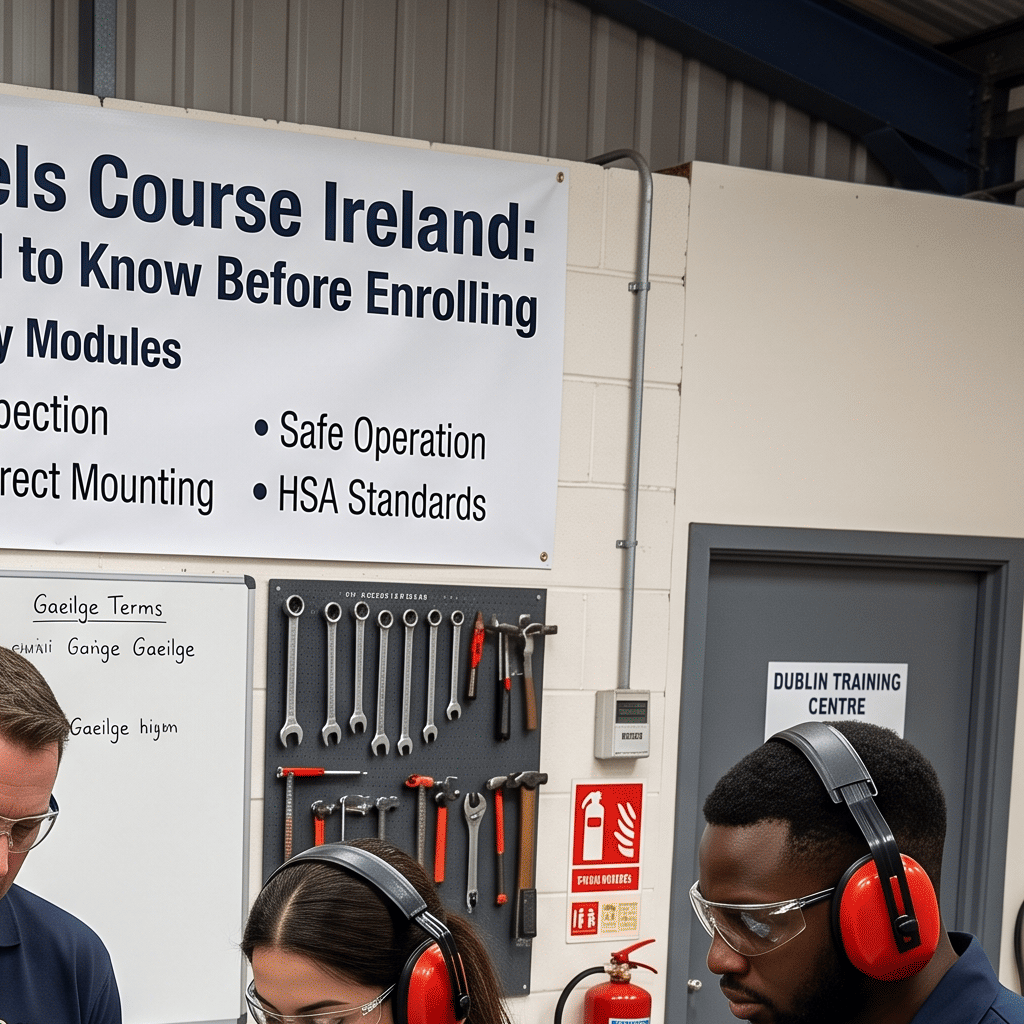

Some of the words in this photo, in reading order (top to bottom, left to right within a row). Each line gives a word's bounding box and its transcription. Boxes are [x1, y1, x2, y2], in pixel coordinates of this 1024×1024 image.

[89, 154, 302, 238] Course
[325, 181, 535, 262] Ireland:
[19, 237, 63, 285] to
[80, 241, 201, 297] Know
[217, 256, 351, 312] Before
[367, 270, 537, 338] Enrolling
[26, 318, 181, 369] Modules
[280, 410, 344, 450] Safe
[354, 416, 486, 461] Operation
[72, 463, 213, 515] Mounting
[279, 475, 338, 514] HSA
[348, 479, 486, 521] Standards
[33, 593, 99, 624] Gaeilge
[107, 595, 163, 617] Terms
[133, 637, 195, 664] Gaeilge
[774, 672, 828, 690] DUBLIN
[833, 673, 901, 691] TRAINING
[808, 697, 866, 715] CENTRE
[70, 718, 129, 744] Gaeilge
